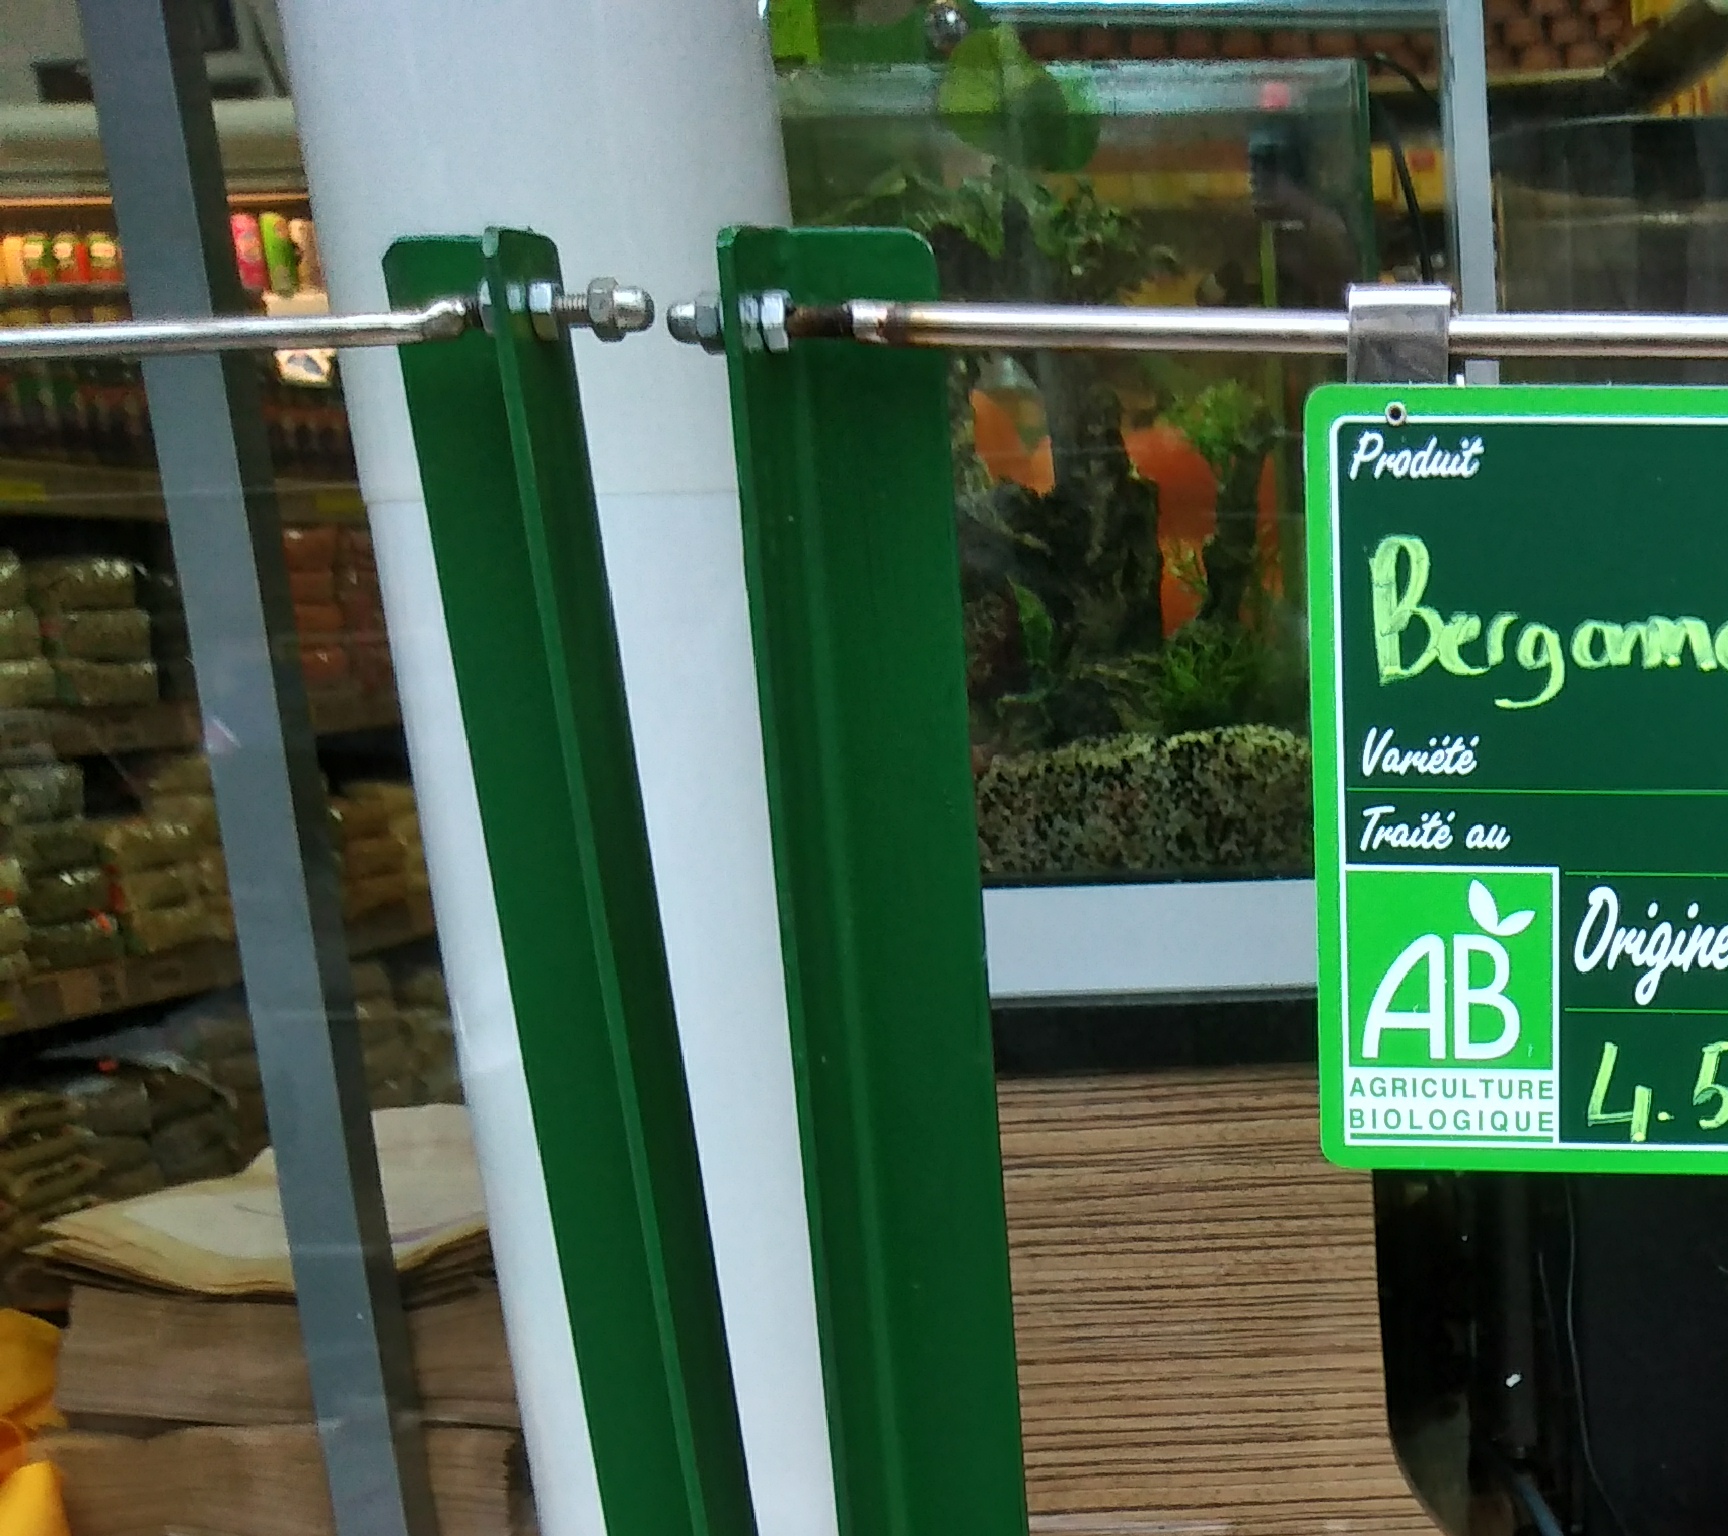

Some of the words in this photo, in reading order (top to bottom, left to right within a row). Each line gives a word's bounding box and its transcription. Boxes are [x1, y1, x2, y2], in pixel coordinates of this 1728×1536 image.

[1349, 431, 1484, 480] Produit
[1361, 727, 1479, 776] Variété
[1359, 806, 1454, 852] Traité
[1465, 823, 1511, 850] au
[1361, 933, 1520, 1061] AB
[1350, 1076, 1554, 1099] AGRICULTURE
[1349, 1108, 1554, 1132] BIOLOGIQUE
